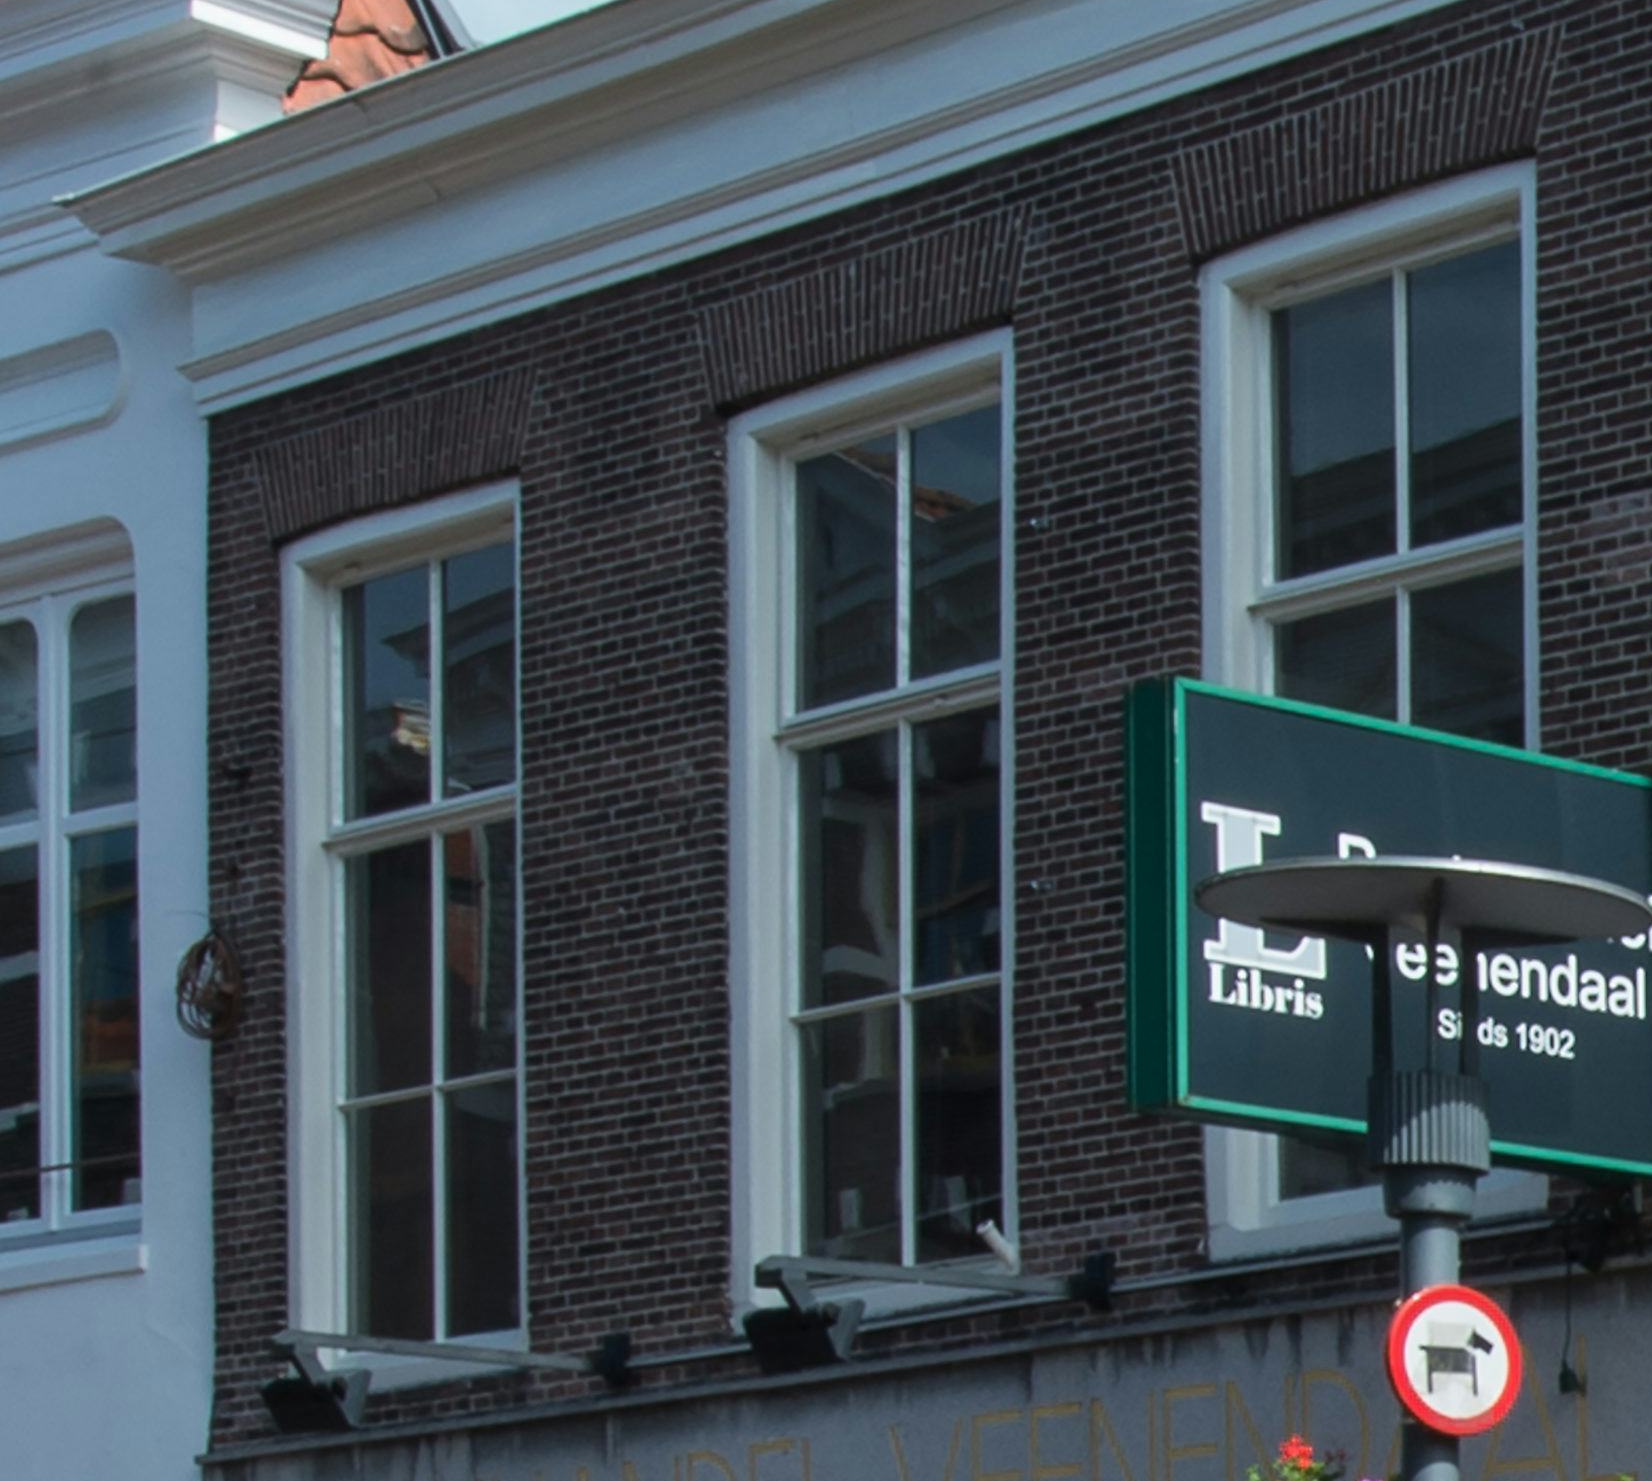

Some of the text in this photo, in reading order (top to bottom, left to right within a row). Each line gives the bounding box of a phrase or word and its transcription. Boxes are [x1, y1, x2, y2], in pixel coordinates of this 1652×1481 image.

[1208, 962, 1324, 1020] Libris
[1366, 942, 1647, 1020] eeendaal
[1438, 1008, 1576, 1060] Sids 1902
